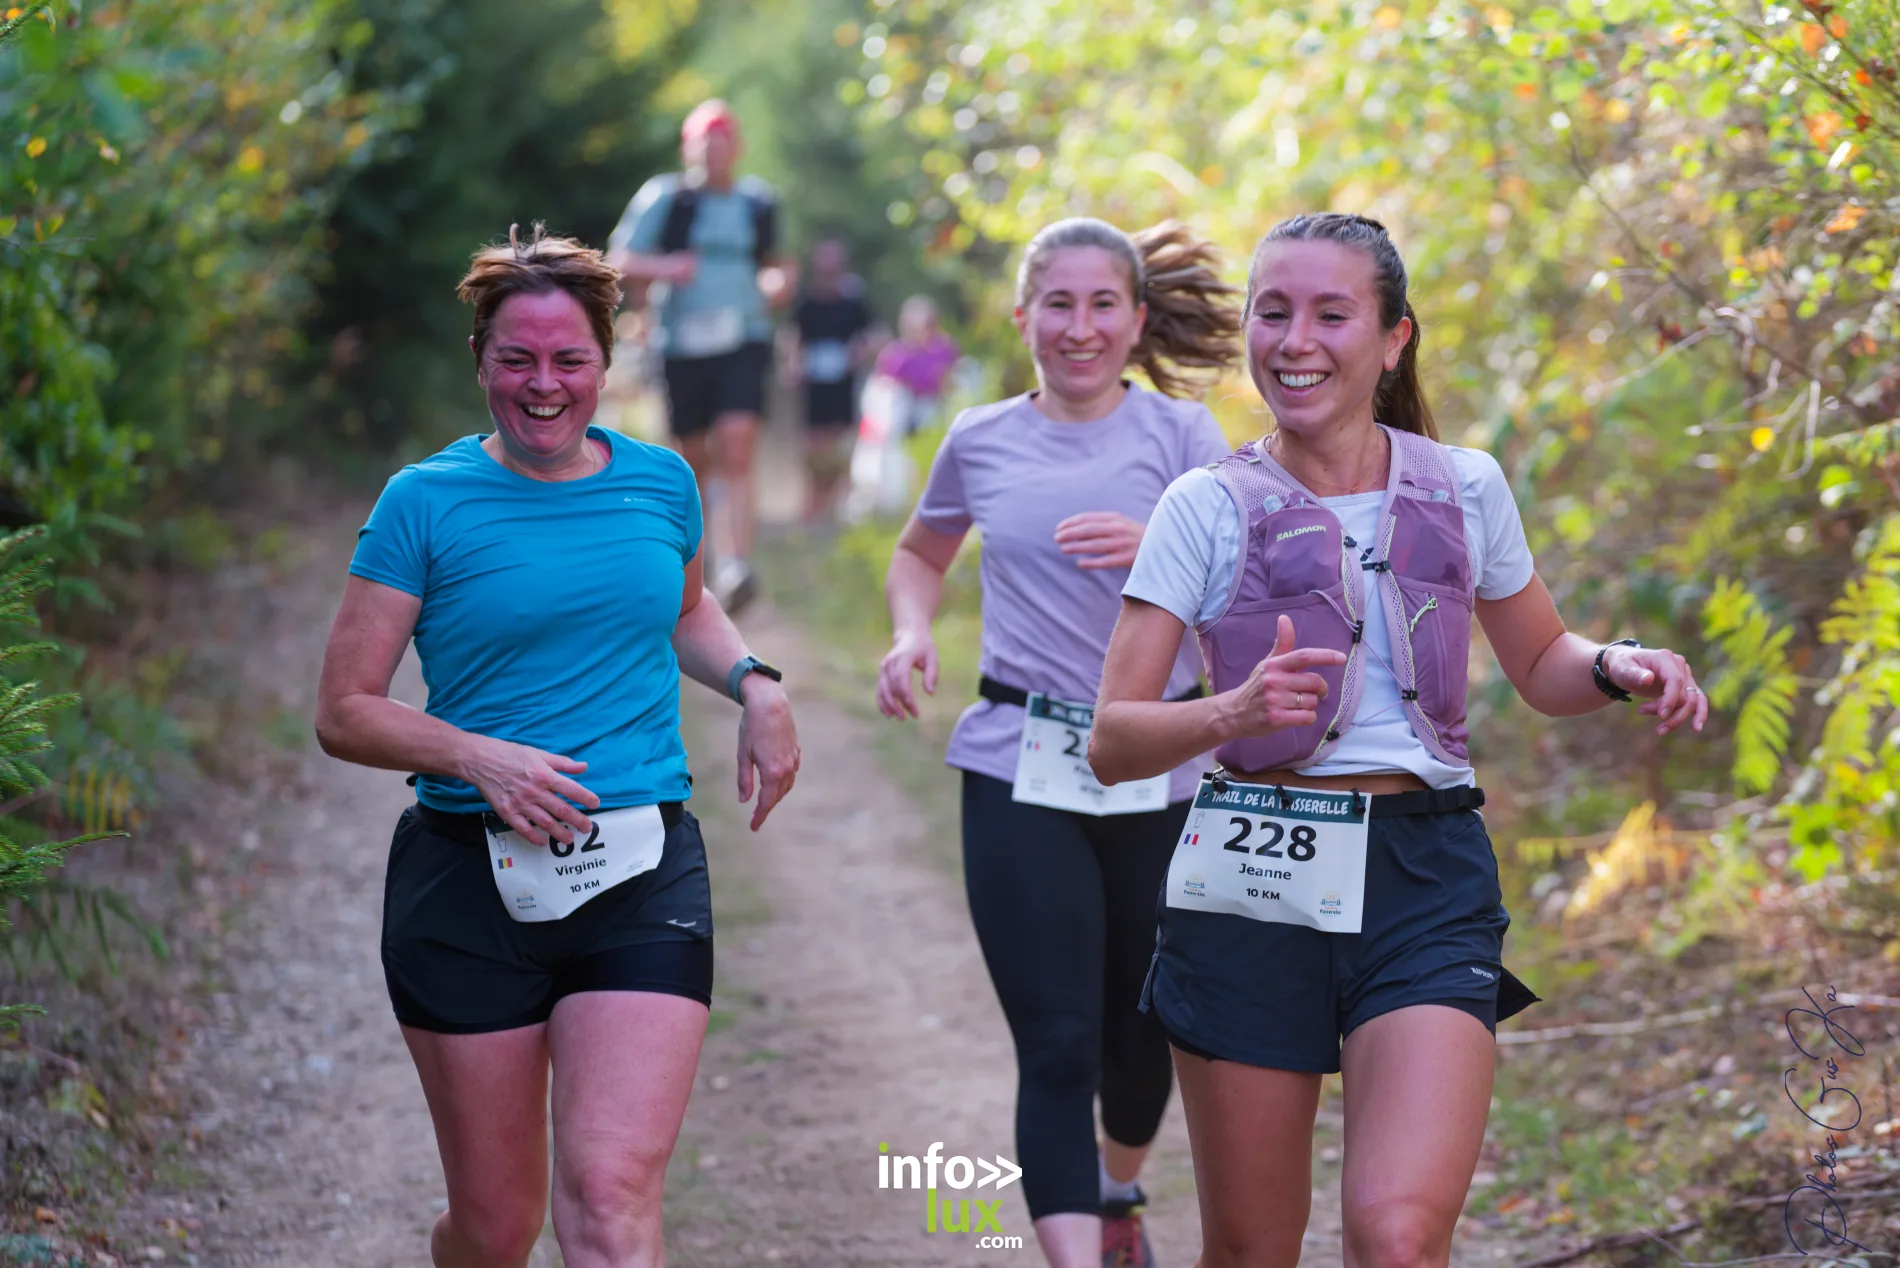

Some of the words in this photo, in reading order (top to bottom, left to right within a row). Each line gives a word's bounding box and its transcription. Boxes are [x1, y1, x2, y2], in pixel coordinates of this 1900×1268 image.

[1276, 525, 1327, 542] SALOMON
[1212, 790, 1241, 804] TRAIL
[1244, 793, 1260, 806] DE
[1261, 794, 1276, 808] LA
[1223, 816, 1317, 862] 228
[555, 858, 607, 877] Virginie
[1238, 863, 1292, 881] Jeanne
[570, 885, 581, 894] 10
[584, 879, 601, 890] KM
[1246, 888, 1259, 898] 10
[1262, 890, 1280, 900] KM
